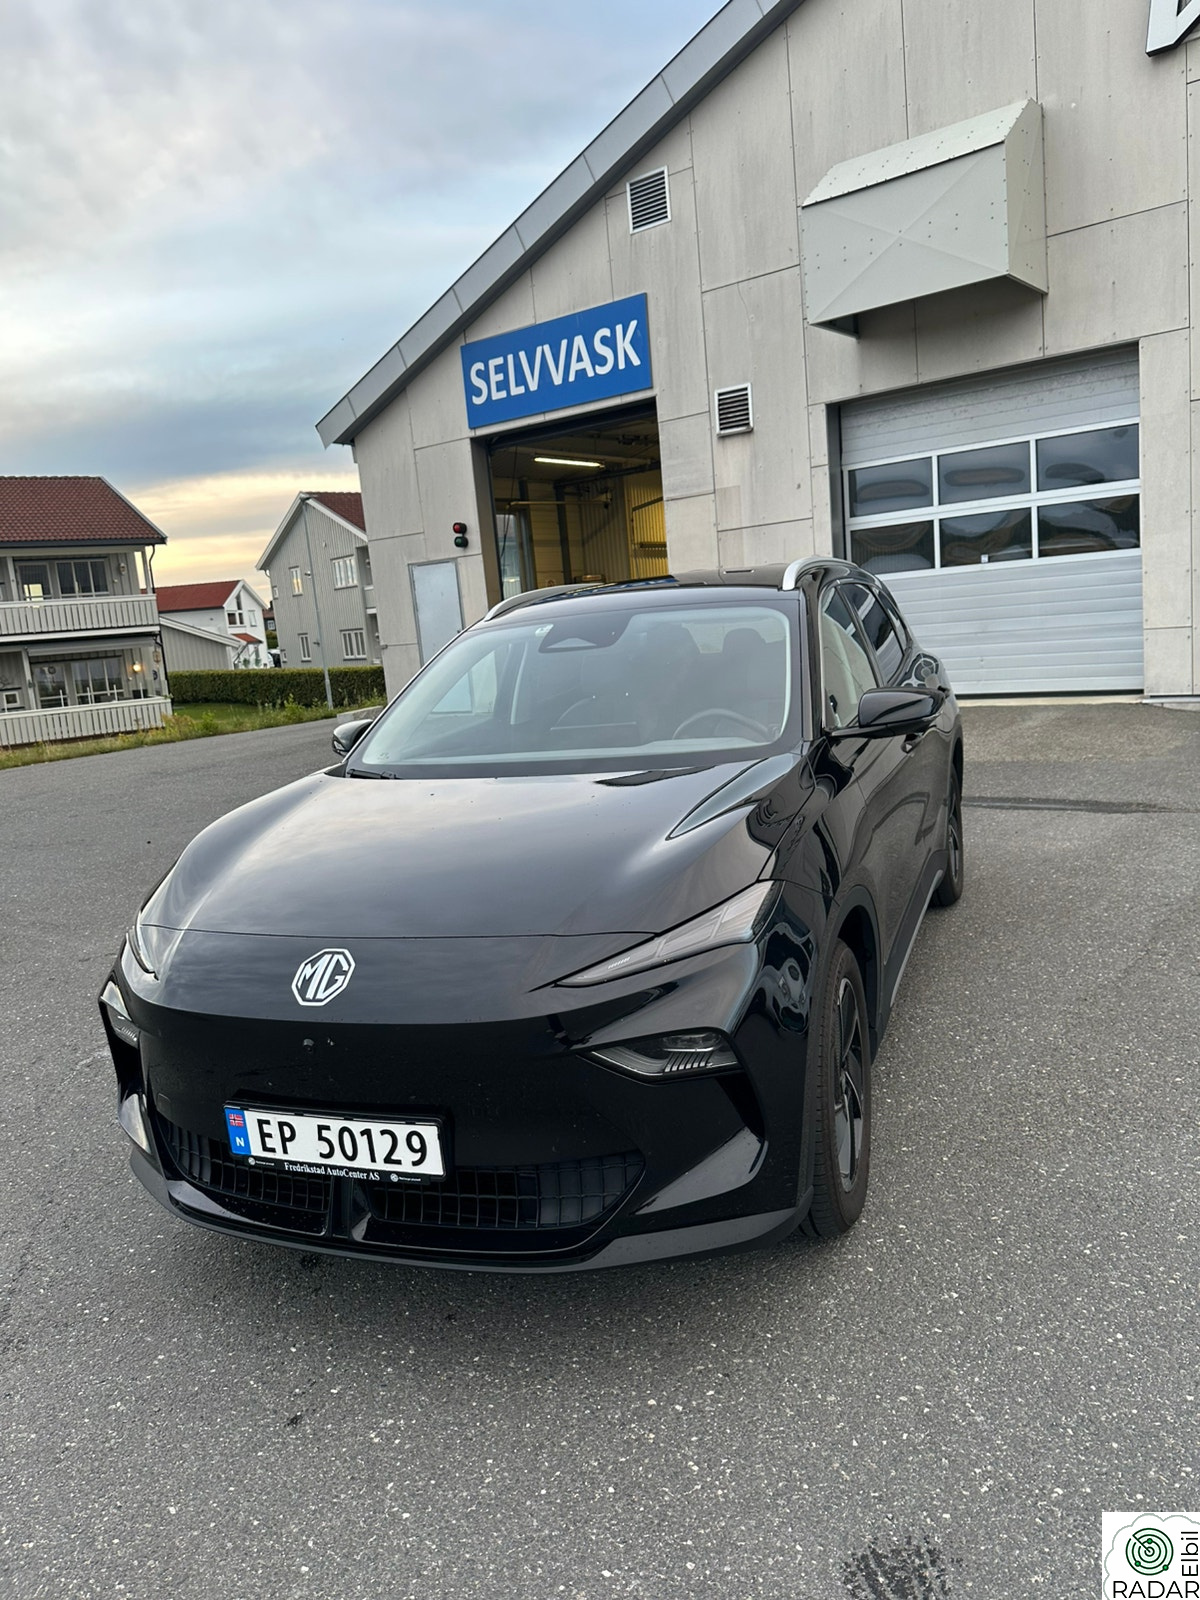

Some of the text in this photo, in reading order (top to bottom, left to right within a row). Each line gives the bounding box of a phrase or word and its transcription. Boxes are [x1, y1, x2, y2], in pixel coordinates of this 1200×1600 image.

[469, 319, 642, 406] SELVVASK
[296, 953, 350, 1001] MG
[235, 1136, 245, 1148] N
[256, 1118, 428, 1167] EP 50129
[284, 1161, 326, 1176] Fredrikstad
[326, 1168, 368, 1181] AutoCenter
[368, 1171, 381, 1181] AS
